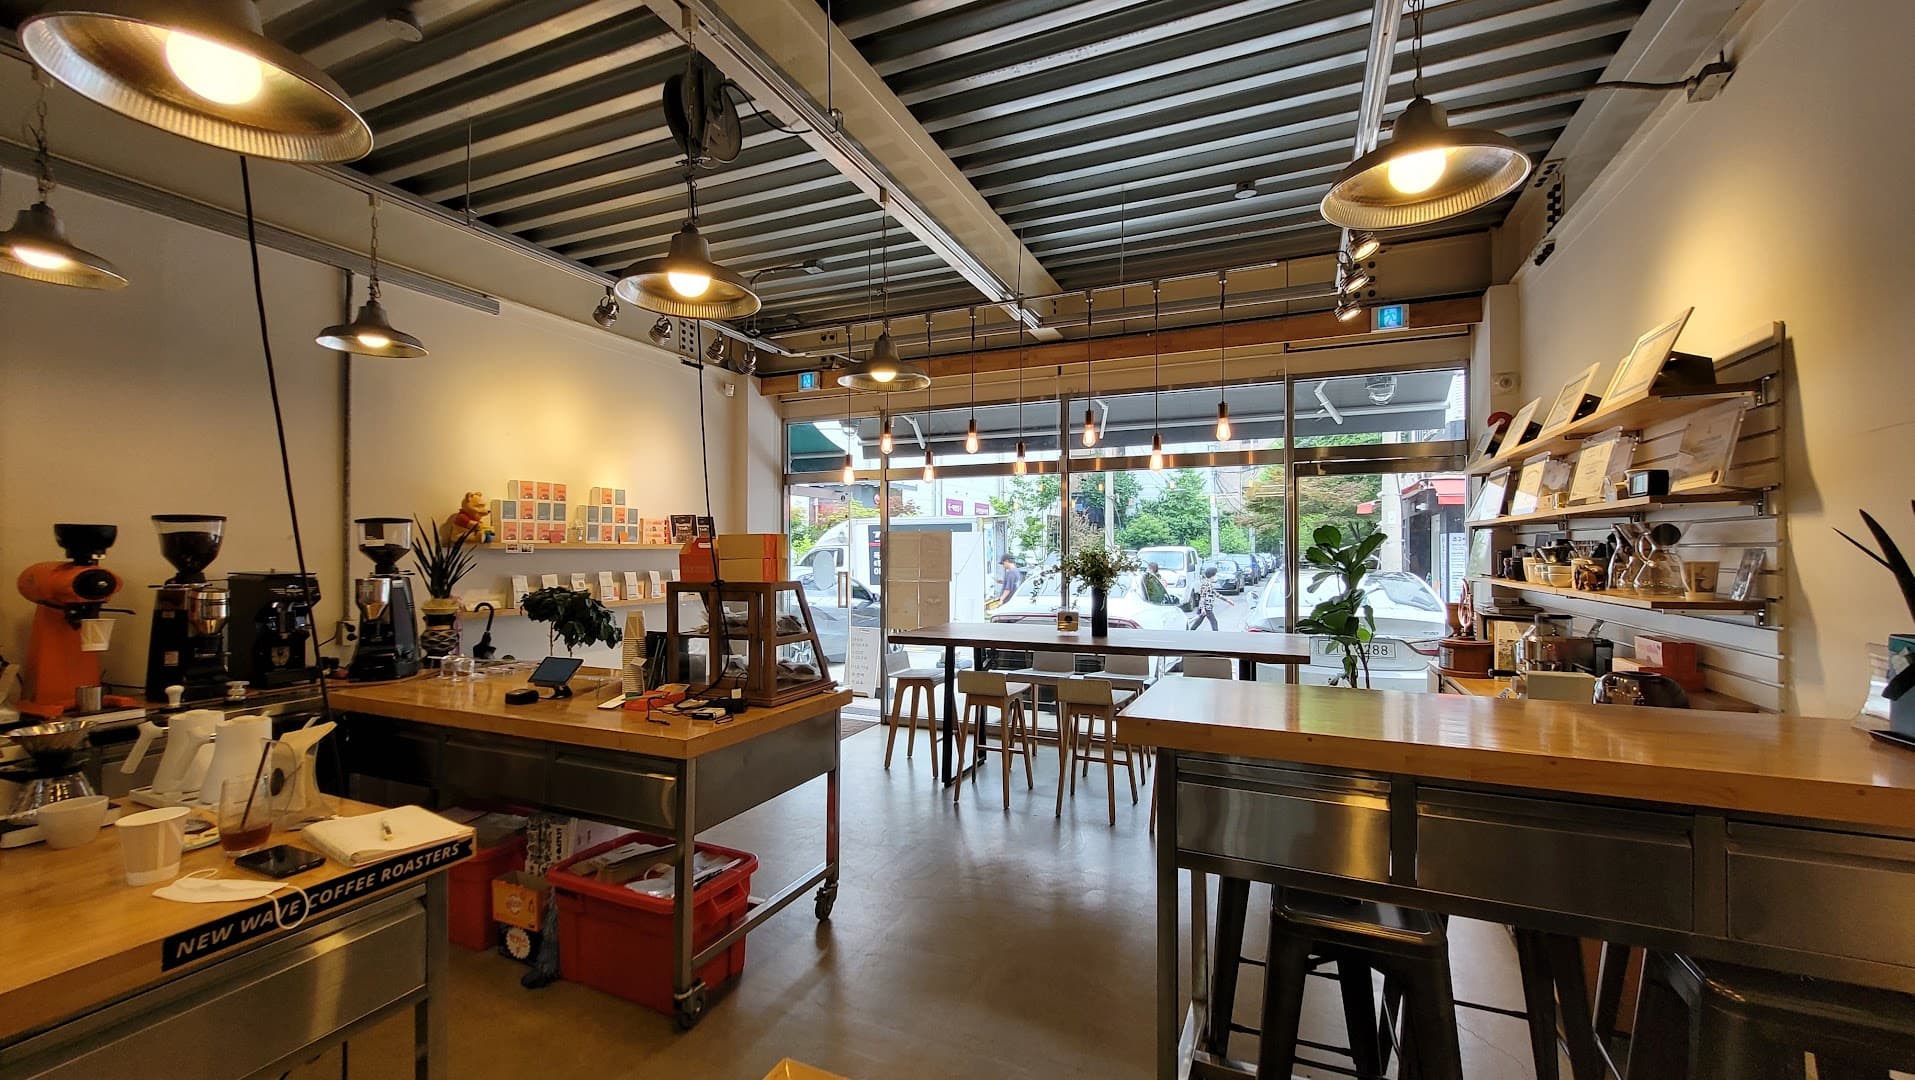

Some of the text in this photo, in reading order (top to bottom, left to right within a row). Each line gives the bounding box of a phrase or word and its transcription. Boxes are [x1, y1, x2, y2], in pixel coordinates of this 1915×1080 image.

[175, 842, 461, 959] NEW WAVE COFFEE ROASTERS
